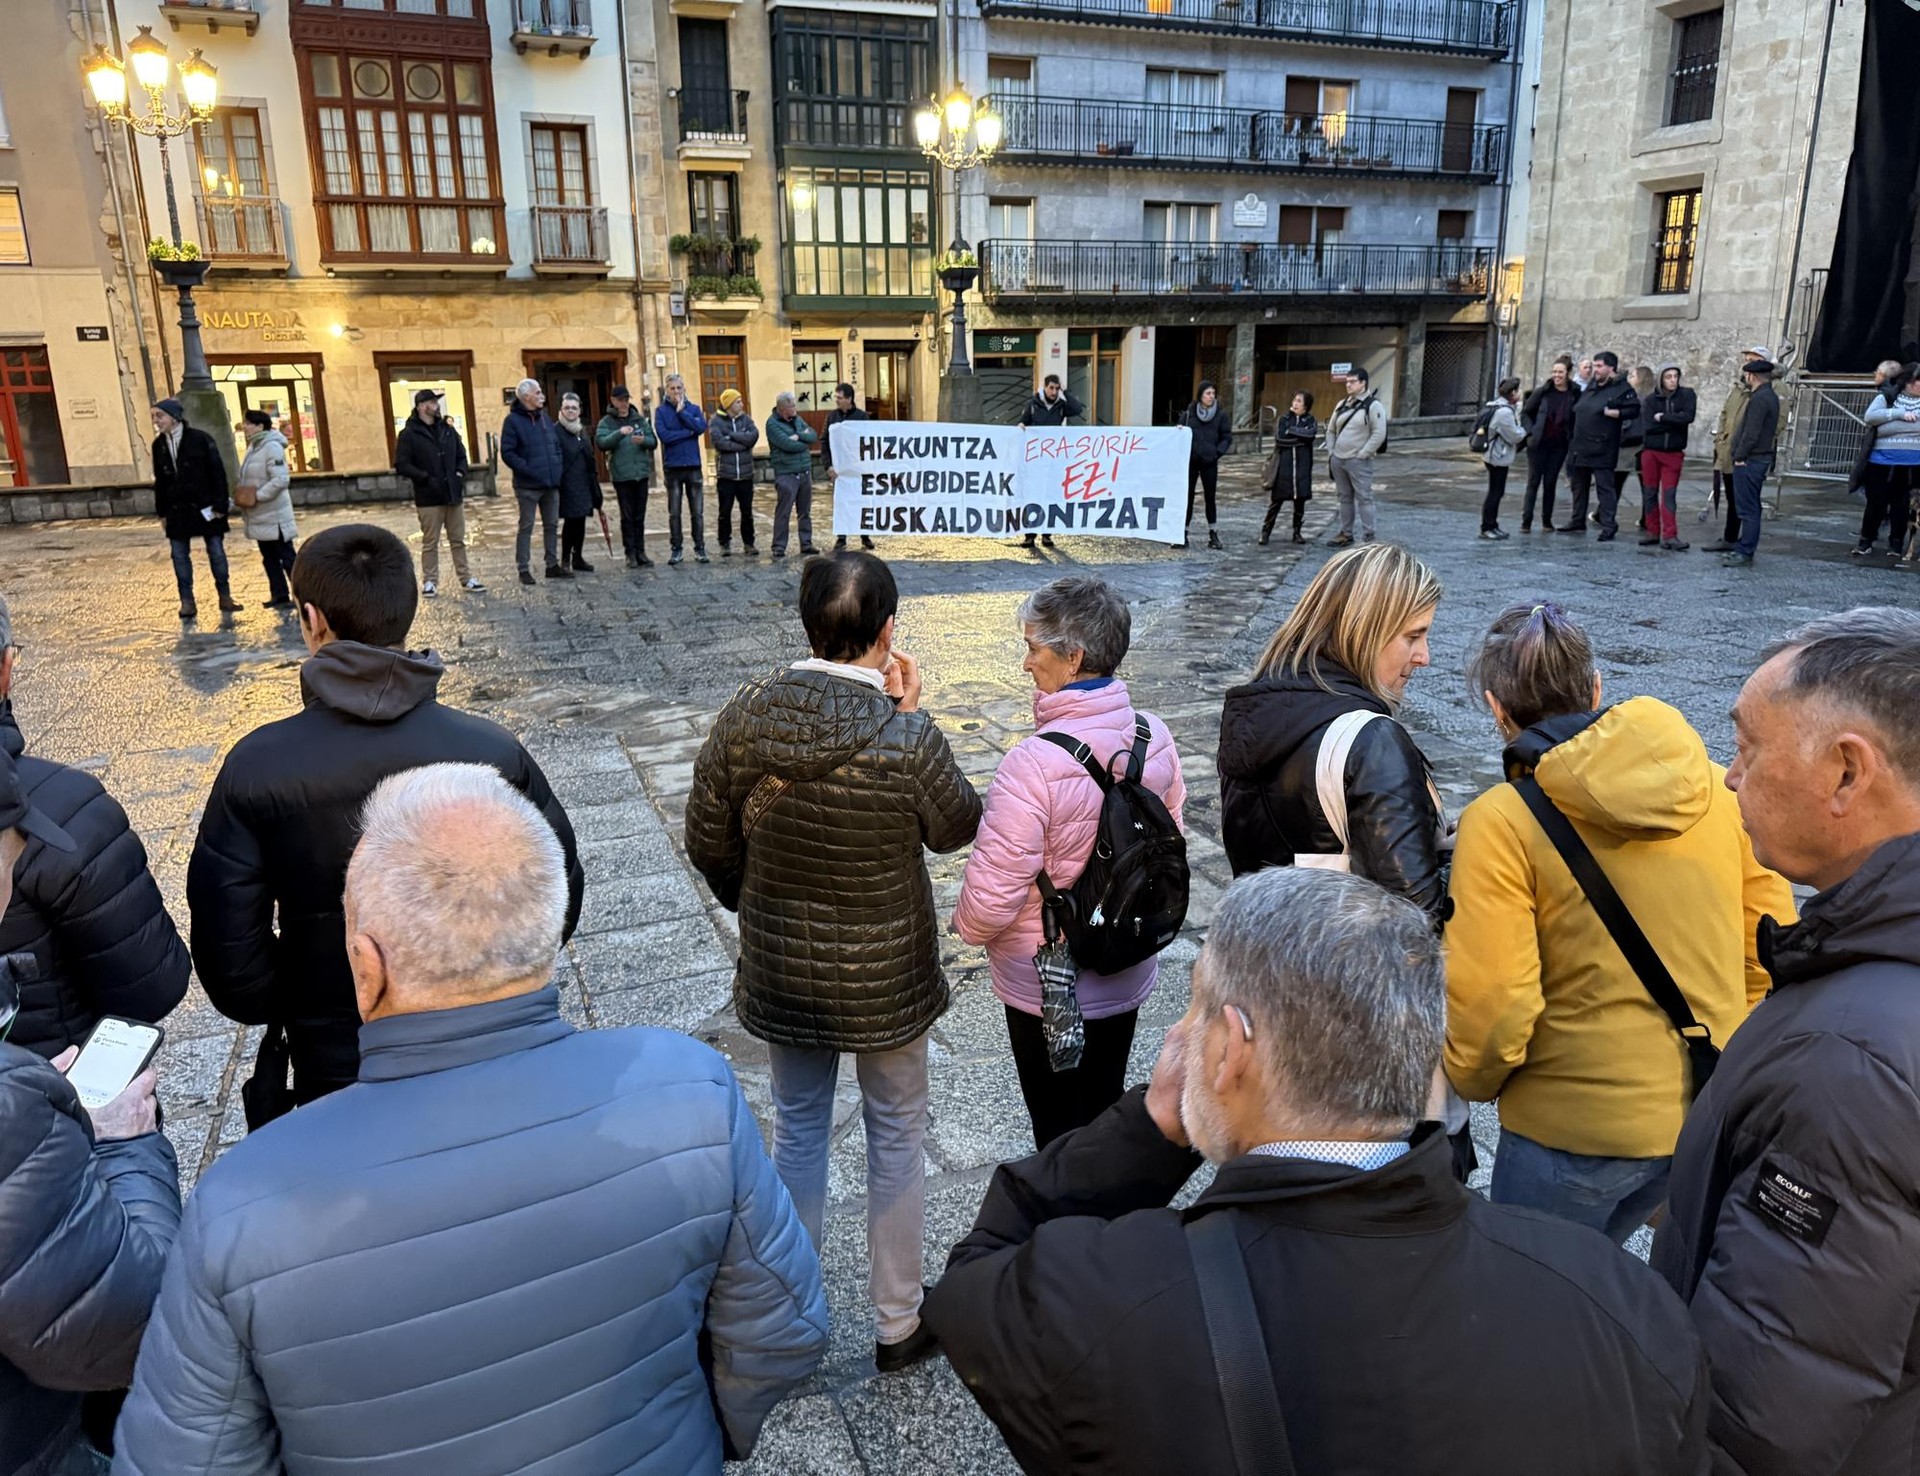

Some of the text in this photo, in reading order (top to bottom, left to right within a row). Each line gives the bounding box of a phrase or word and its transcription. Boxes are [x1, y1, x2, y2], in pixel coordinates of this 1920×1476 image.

[859, 436, 997, 461] HIZKUNTZA
[861, 470, 1015, 496] ESKUBIDEAK
[1061, 456, 1119, 500] EZ!
[1775, 1173, 1812, 1199] ECOALF
